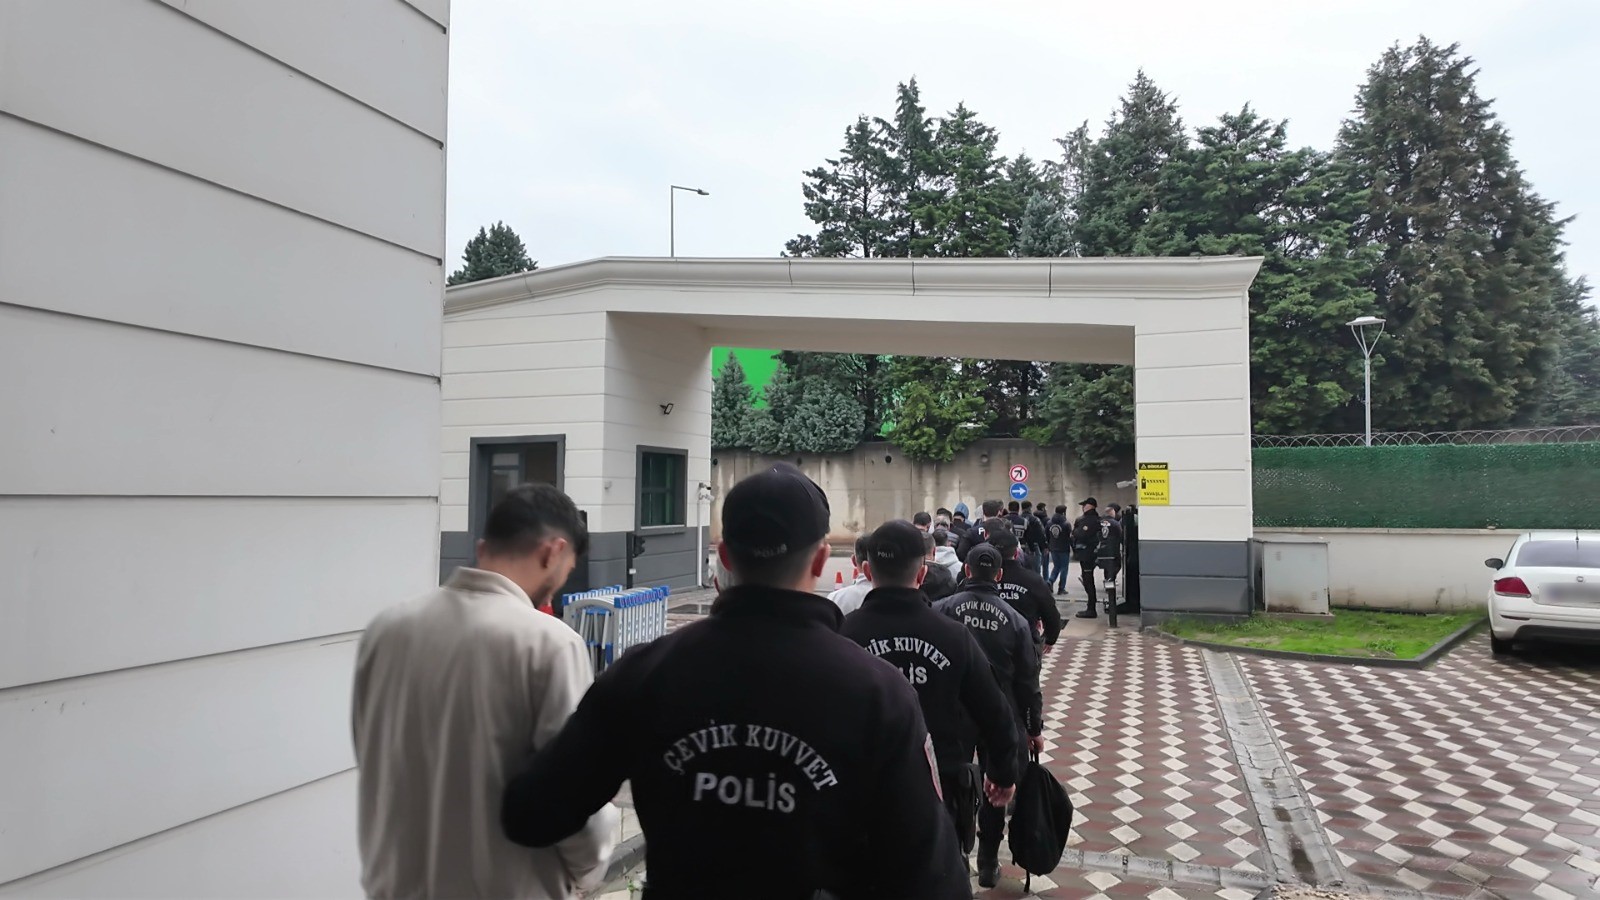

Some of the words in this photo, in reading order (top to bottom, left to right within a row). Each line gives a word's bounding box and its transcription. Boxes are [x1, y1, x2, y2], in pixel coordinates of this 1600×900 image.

[1000, 590, 1020, 600] OLİS
[1003, 583, 1028, 594] KUVVET
[980, 602, 1009, 625] KUVVET
[893, 636, 951, 670] KUVVET
[663, 719, 738, 775] ÇEVİK
[745, 724, 839, 791] KUVVET
[693, 772, 797, 813] POLİS
